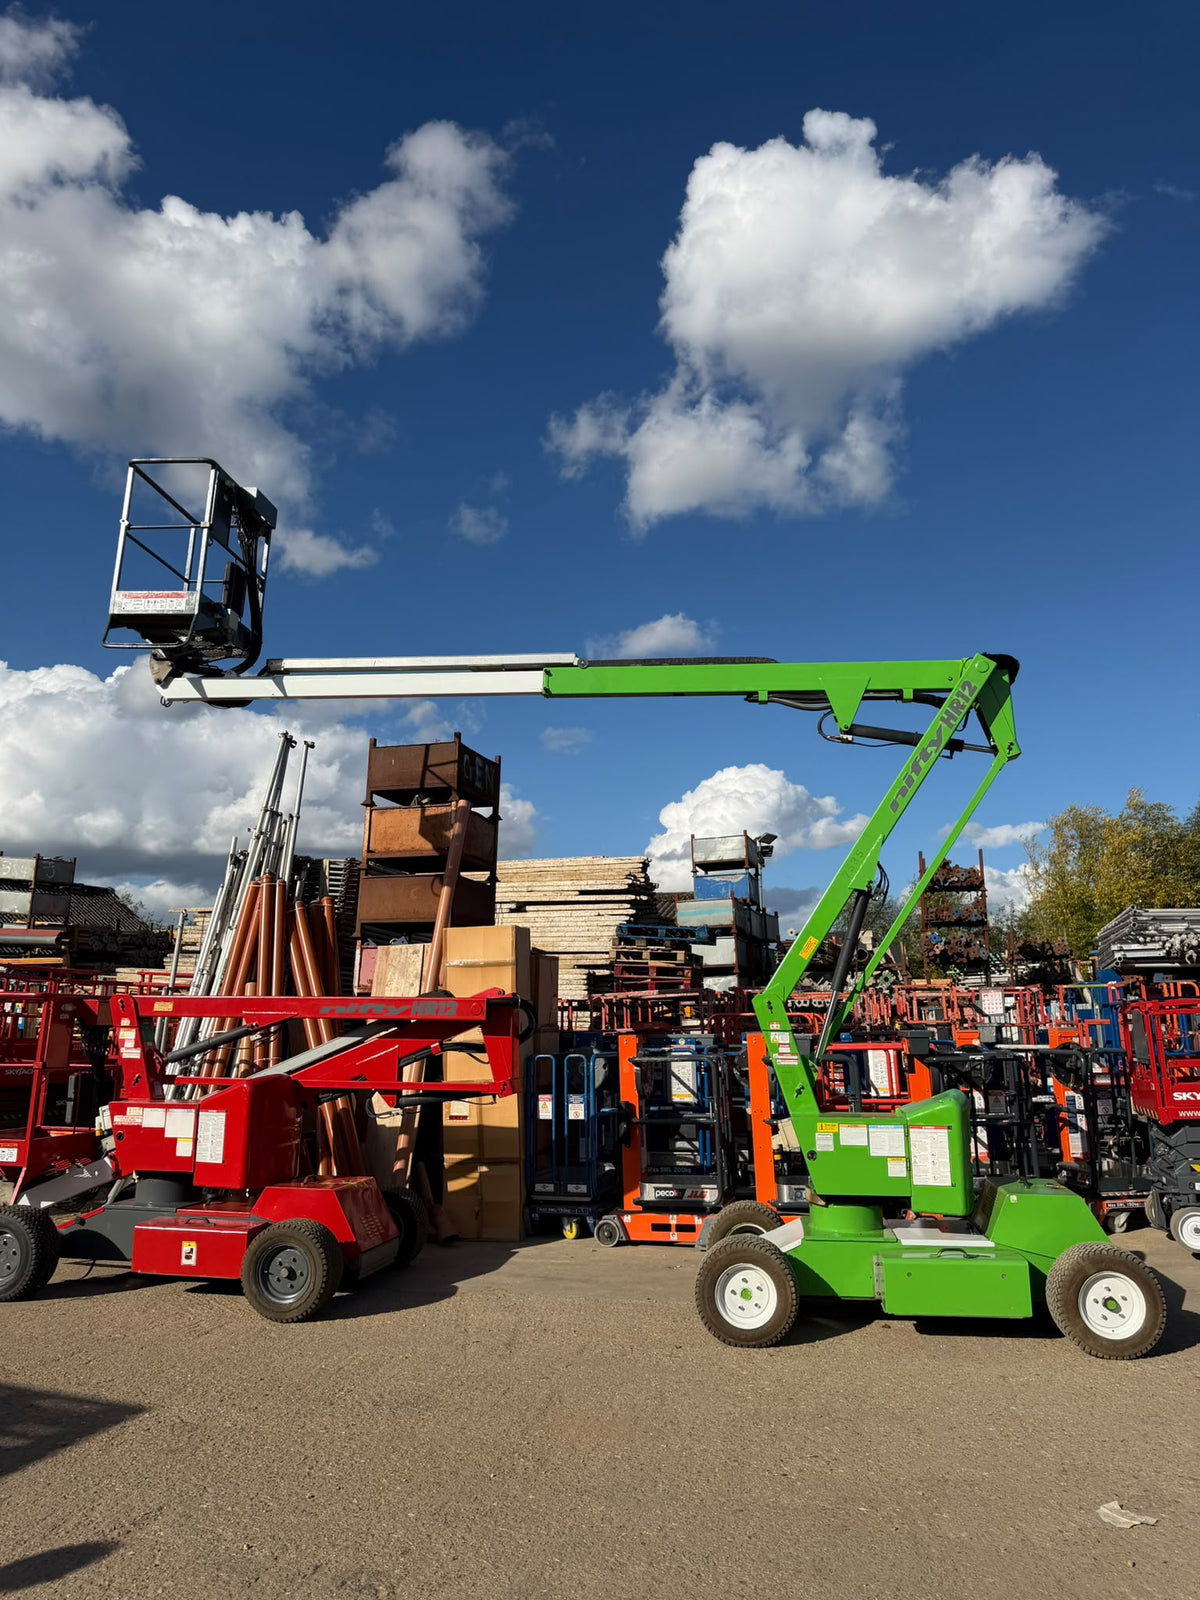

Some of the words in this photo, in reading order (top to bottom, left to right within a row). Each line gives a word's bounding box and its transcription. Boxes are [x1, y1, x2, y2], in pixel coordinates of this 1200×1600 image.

[889, 724, 943, 813] nifty
[939, 680, 978, 730] HR12
[319, 1003, 409, 1016] nifty
[410, 1001, 457, 1016] HR12
[687, 1190, 708, 1198] JLG
